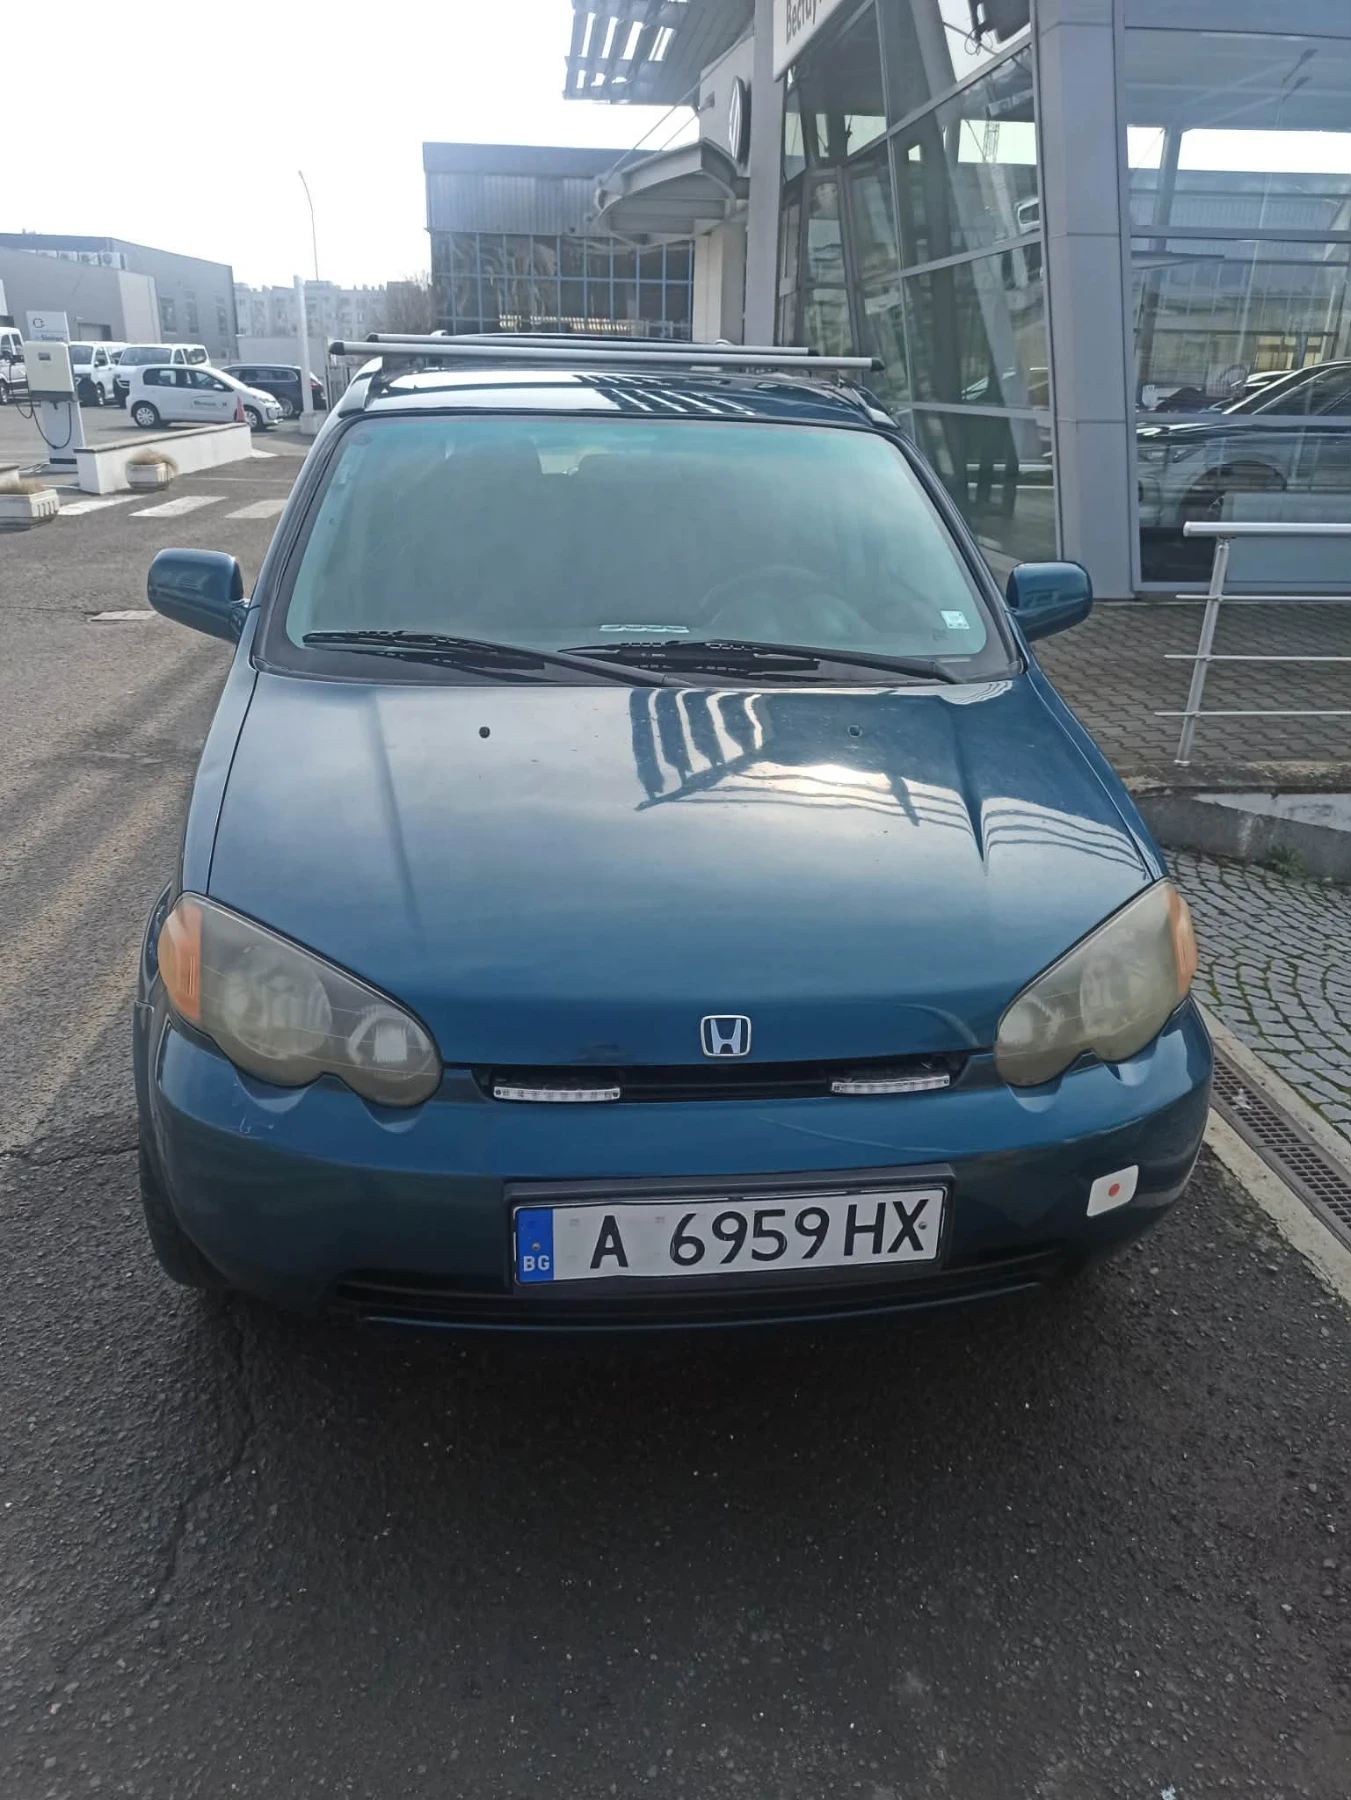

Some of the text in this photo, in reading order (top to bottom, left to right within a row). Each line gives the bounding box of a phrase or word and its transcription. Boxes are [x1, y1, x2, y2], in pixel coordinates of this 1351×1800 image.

[590, 1198, 930, 1269] A 6959 HX
[523, 1255, 550, 1272] BG
